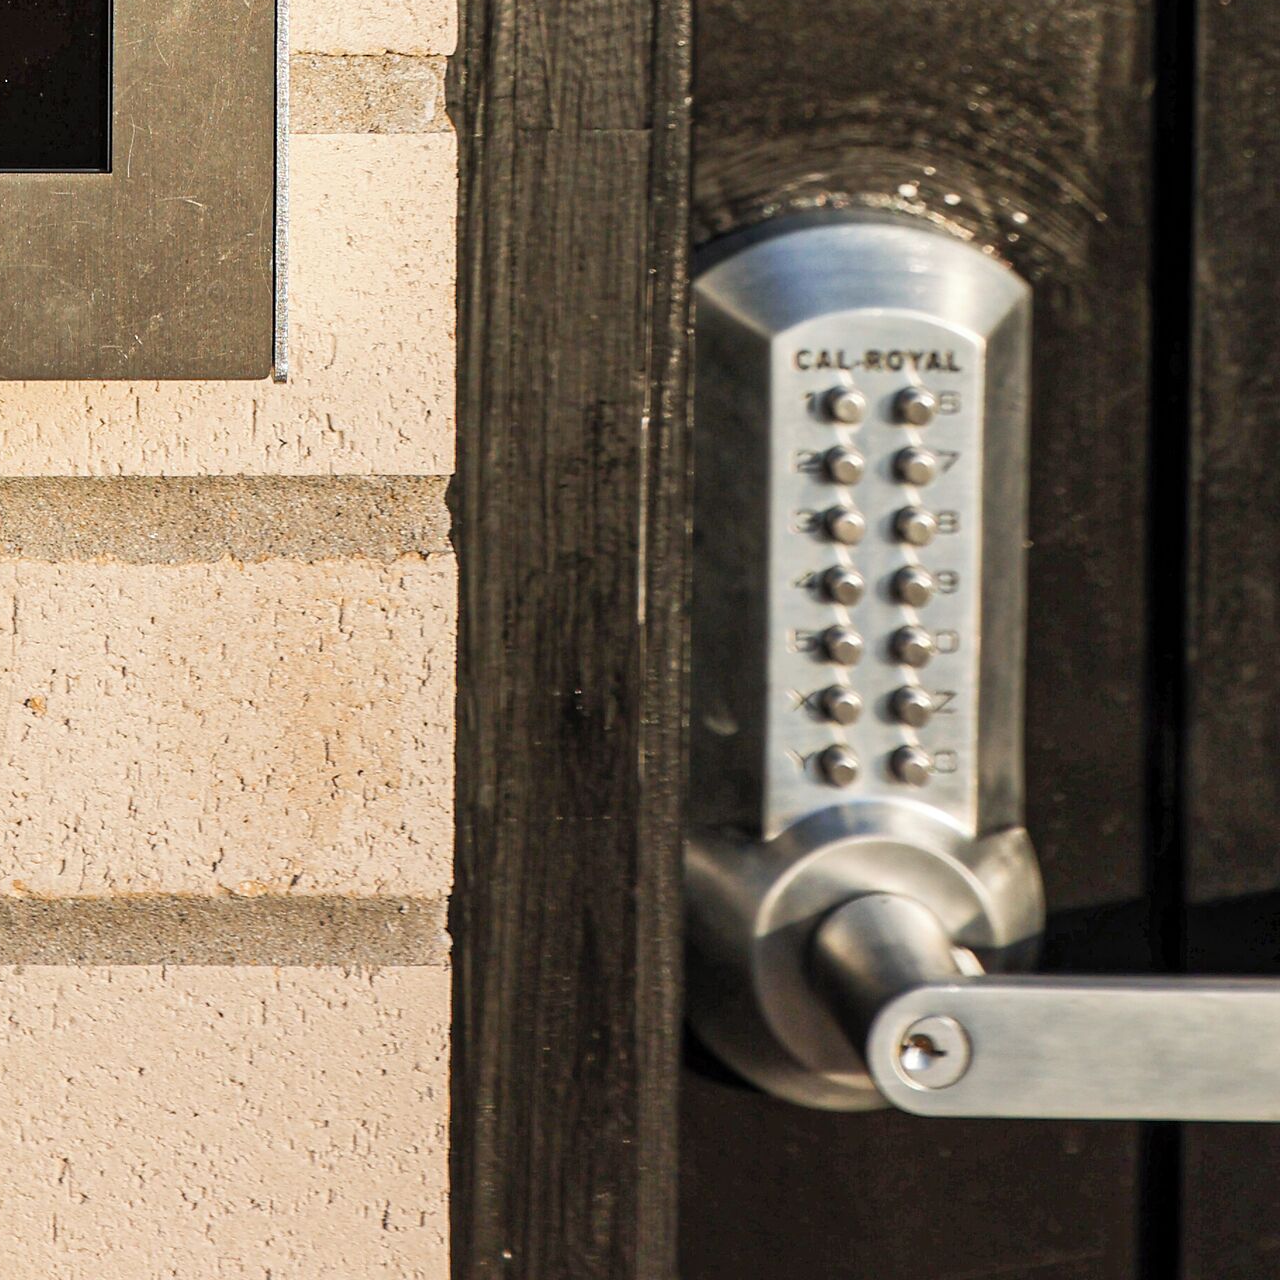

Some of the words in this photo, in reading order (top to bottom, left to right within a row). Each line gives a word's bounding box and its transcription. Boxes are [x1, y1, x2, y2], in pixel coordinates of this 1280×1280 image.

[795, 350, 960, 372] CAL-ROYAL
[795, 450, 820, 474] 2
[935, 450, 960, 474] 7
[793, 629, 819, 653] 5
[791, 689, 819, 713] X
[933, 690, 958, 714] Z
[789, 749, 817, 772] Y
